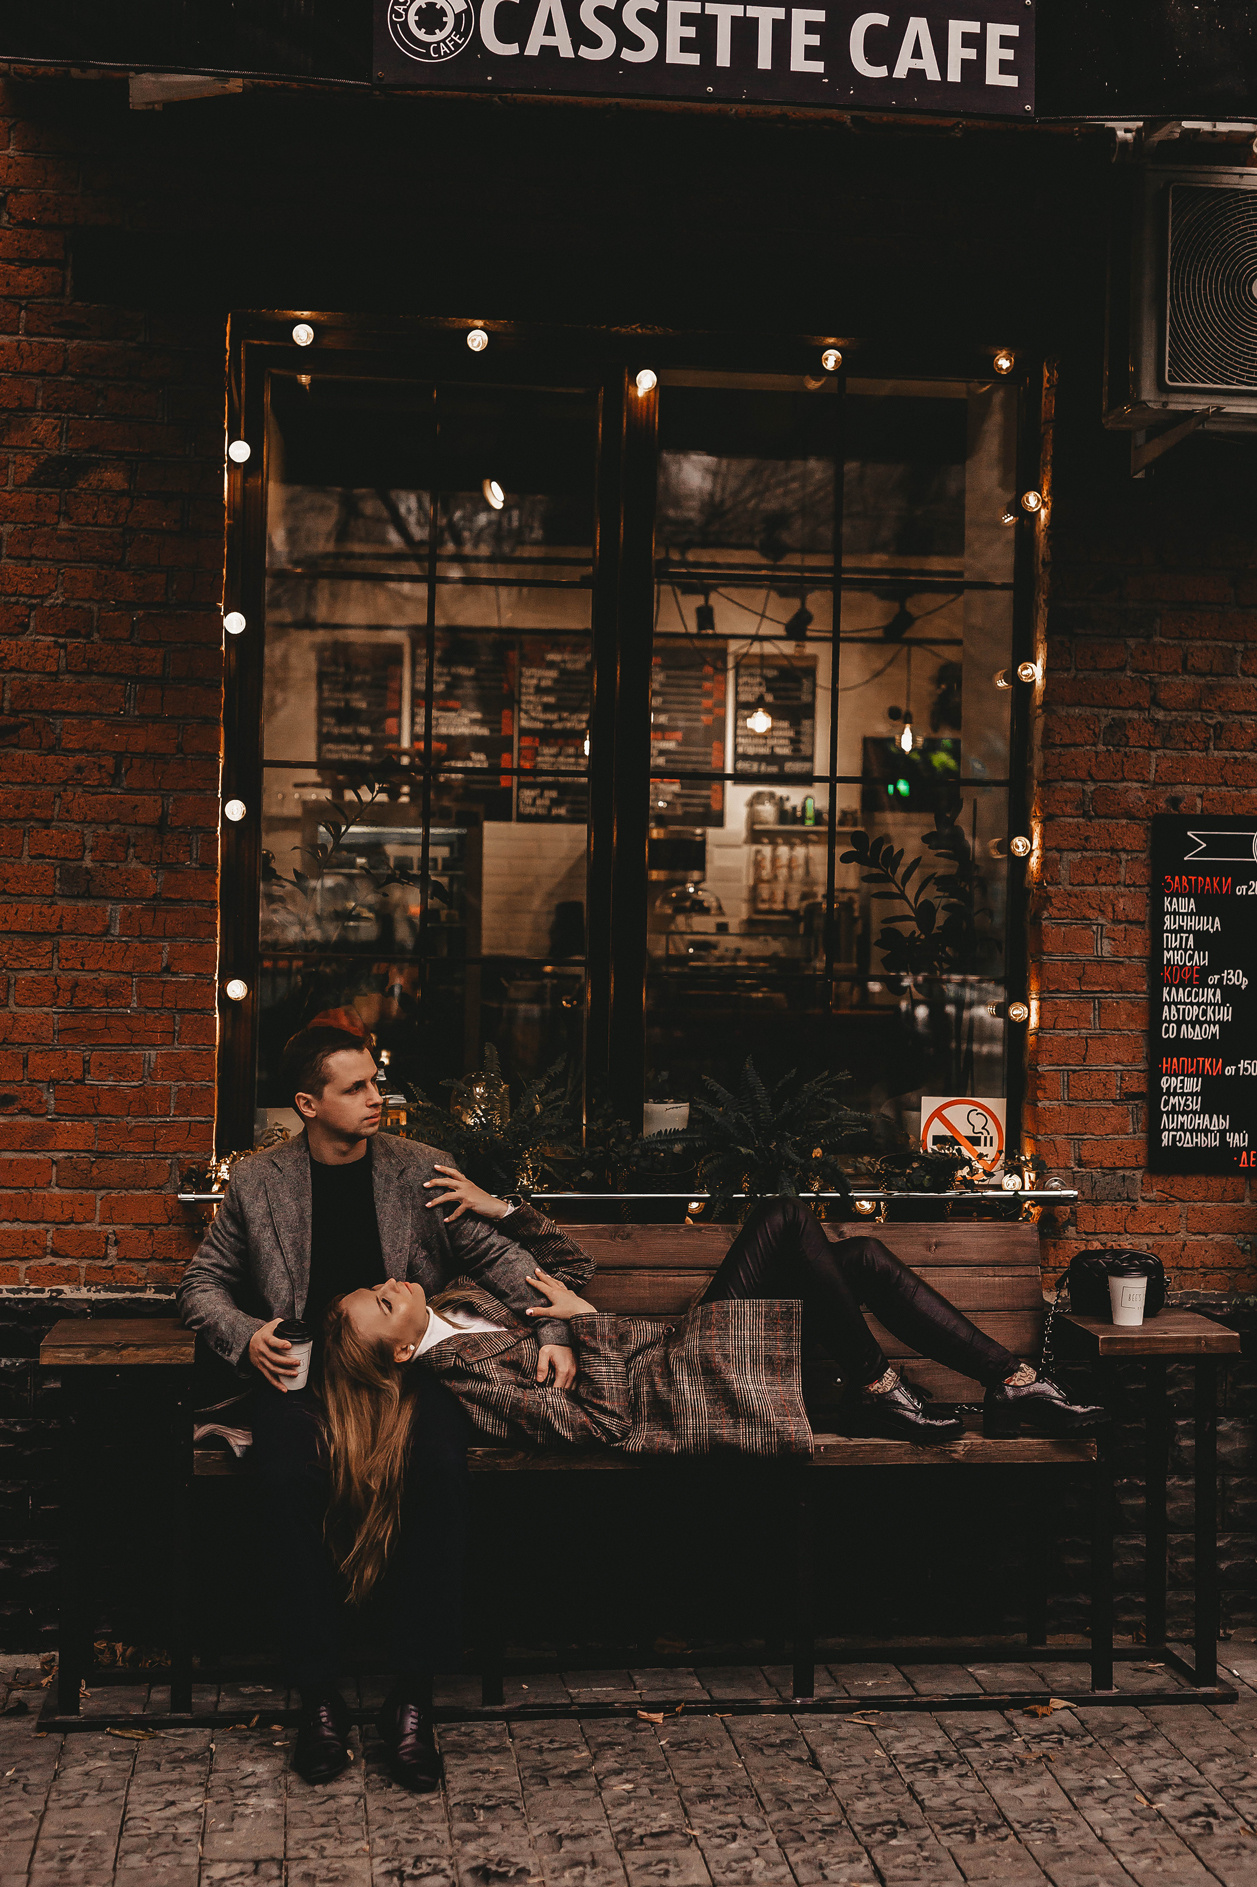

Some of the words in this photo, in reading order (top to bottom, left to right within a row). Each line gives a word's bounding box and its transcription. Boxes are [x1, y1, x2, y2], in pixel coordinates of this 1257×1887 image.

[430, 31, 465, 57] CAFE
[480, 0, 826, 73] CASSETTE
[849, 12, 1020, 87] CAFE
[1164, 875, 1232, 895] ЗАВТРАКИ
[1236, 885, 1248, 895] от
[1248, 880, 1257, 895] 2
[1164, 896, 1196, 913] КАША
[1163, 914, 1222, 934] ЯИЧНИЦА
[1163, 932, 1194, 949] ПИТА
[1163, 949, 1209, 967] МЮСЛИ
[1164, 965, 1201, 985] КОФЕ
[1207, 974, 1221, 985] от
[1162, 986, 1222, 1004] КЛАССИКА
[1162, 1003, 1233, 1022] АВТОРСКИЙ
[1161, 1022, 1177, 1039] СО
[1180, 1023, 1220, 1040] ЛЬДОМ
[1162, 1056, 1223, 1076] НАПИТКИ
[1224, 1066, 1237, 1076] от
[1160, 1075, 1202, 1093] ФРЕШИ
[1160, 1095, 1202, 1112] СМУЗИ
[1160, 1113, 1230, 1130] ЛИМОНАДЫ
[1161, 1130, 1220, 1148] ЯГОДНЫЙ
[1226, 1130, 1249, 1148] ЧАЙ
